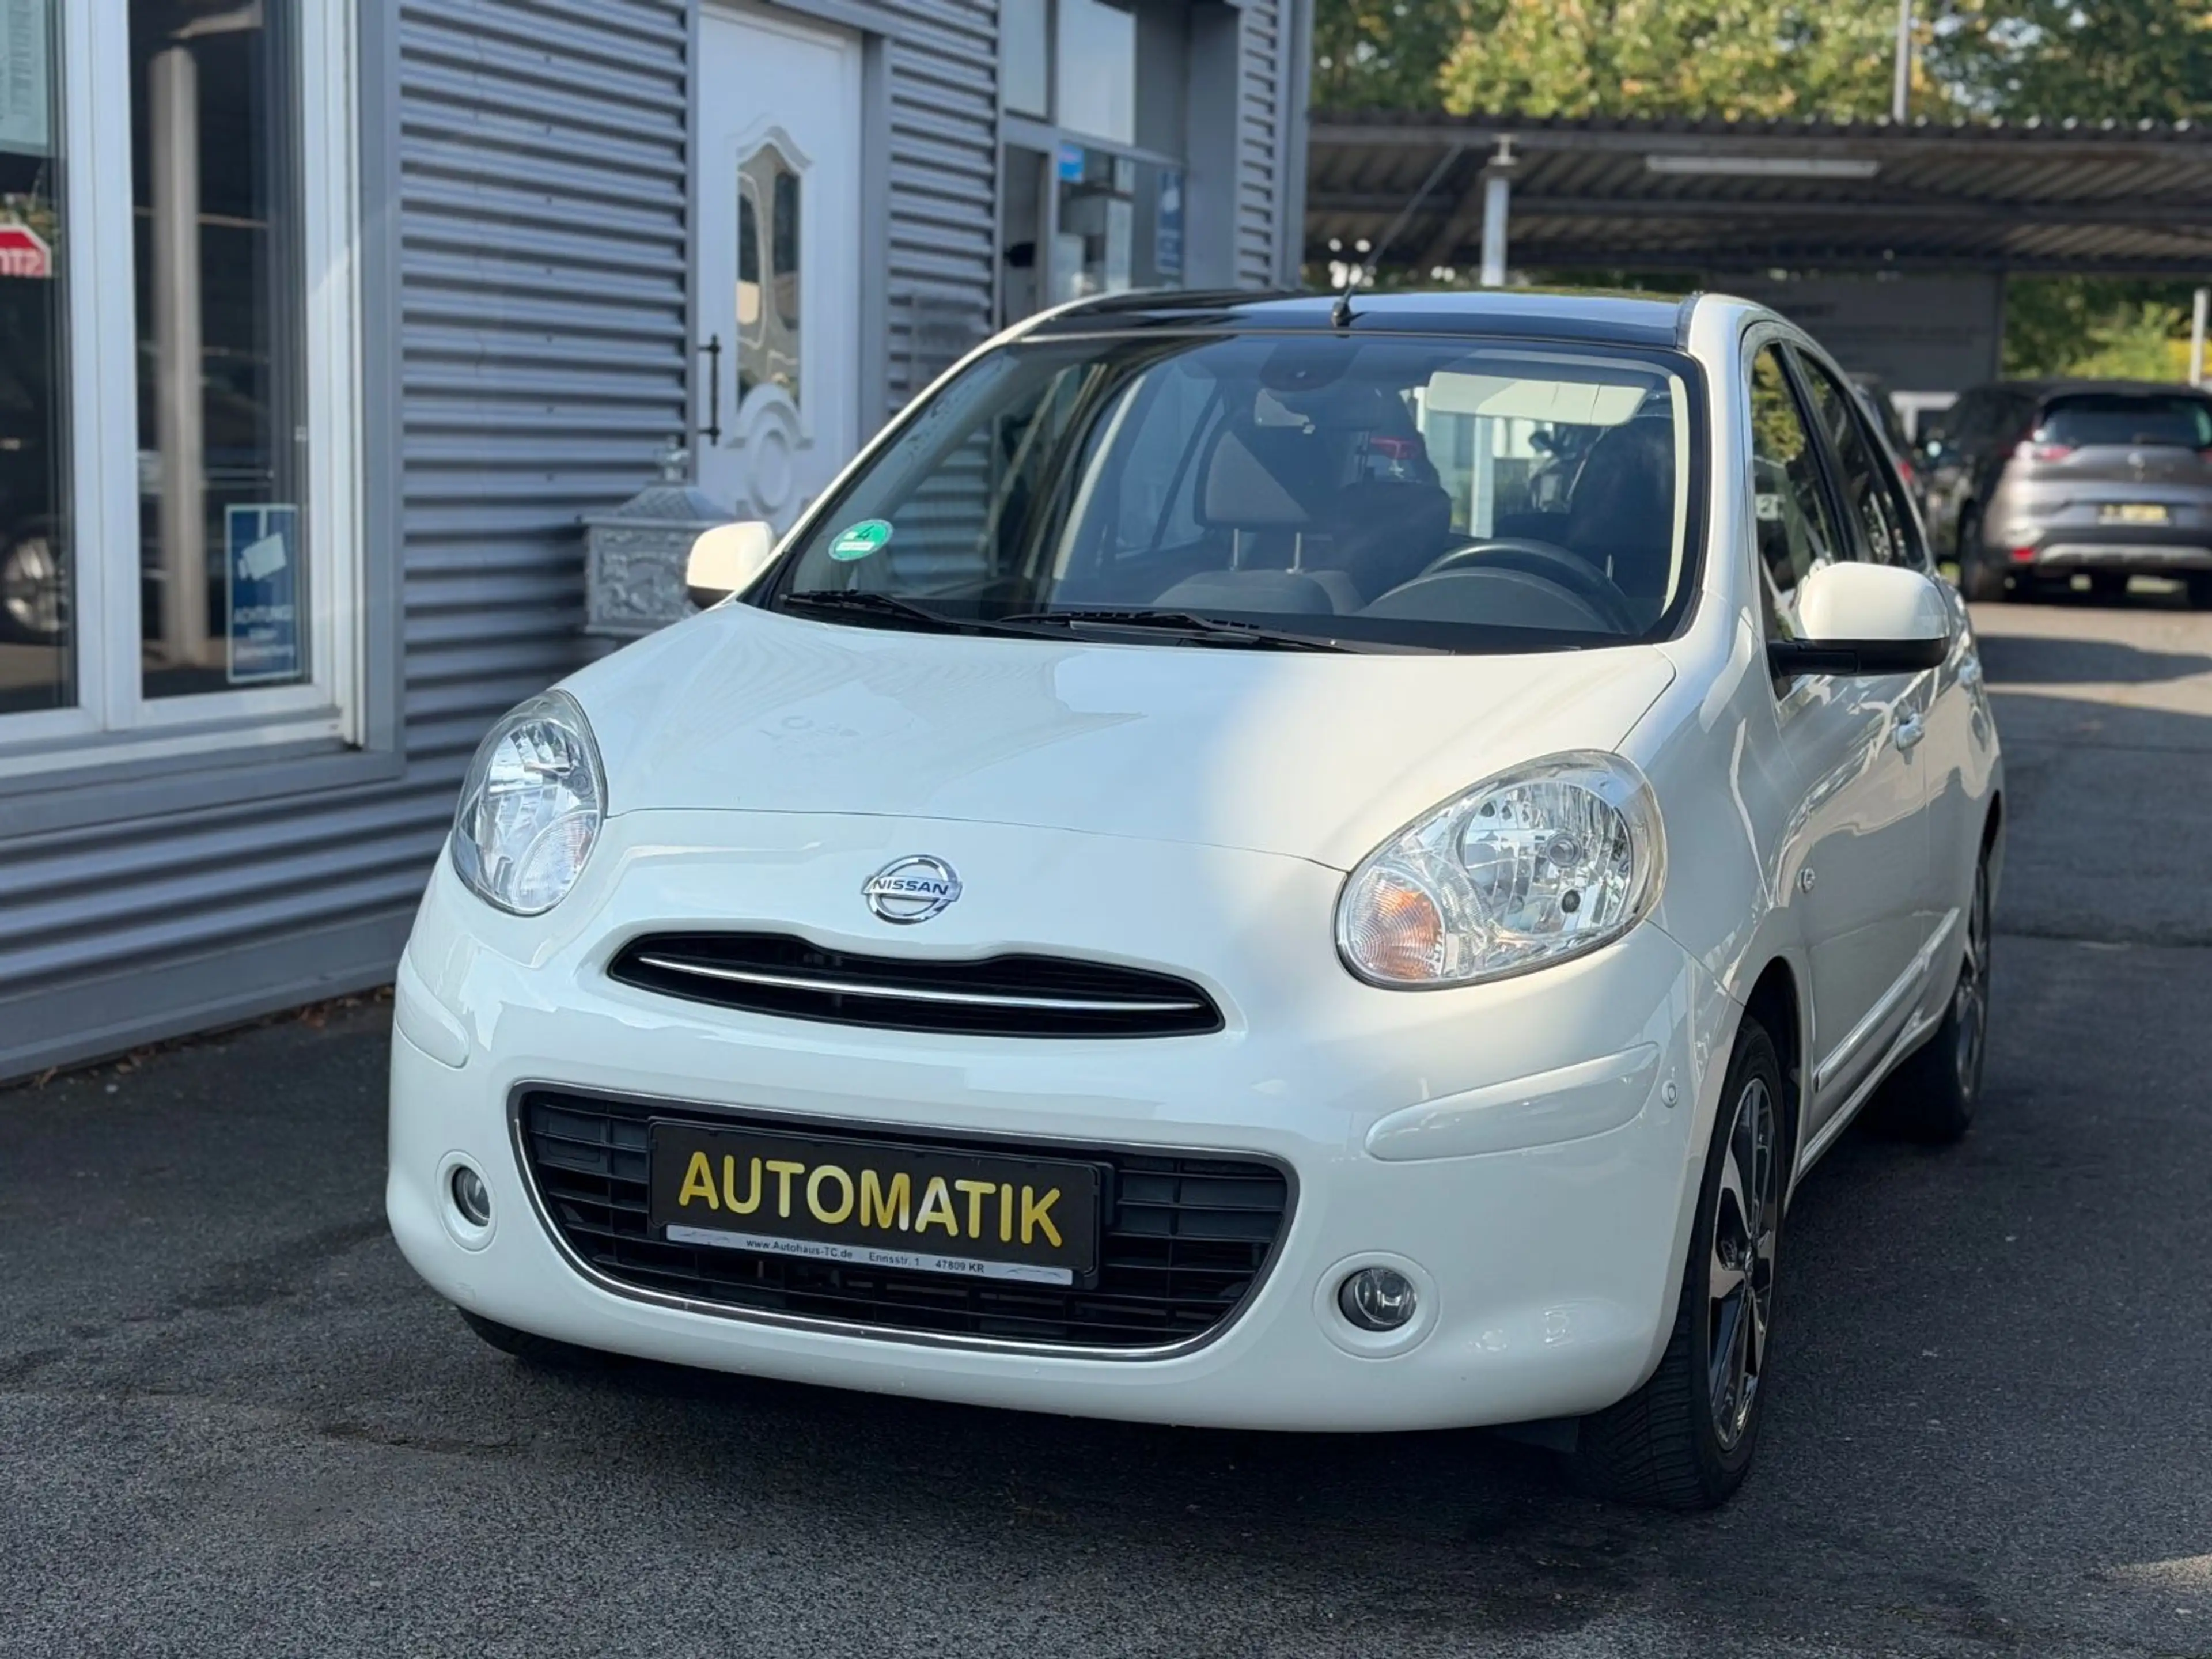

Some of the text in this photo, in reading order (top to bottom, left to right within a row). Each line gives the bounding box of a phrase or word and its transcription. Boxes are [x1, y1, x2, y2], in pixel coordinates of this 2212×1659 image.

[872, 879, 949, 895] NISSAN
[678, 1151, 1063, 1247] AUTOMATIK
[746, 1240, 853, 1260] www.Autohaus-TC.de
[969, 1262, 984, 1274] KR
